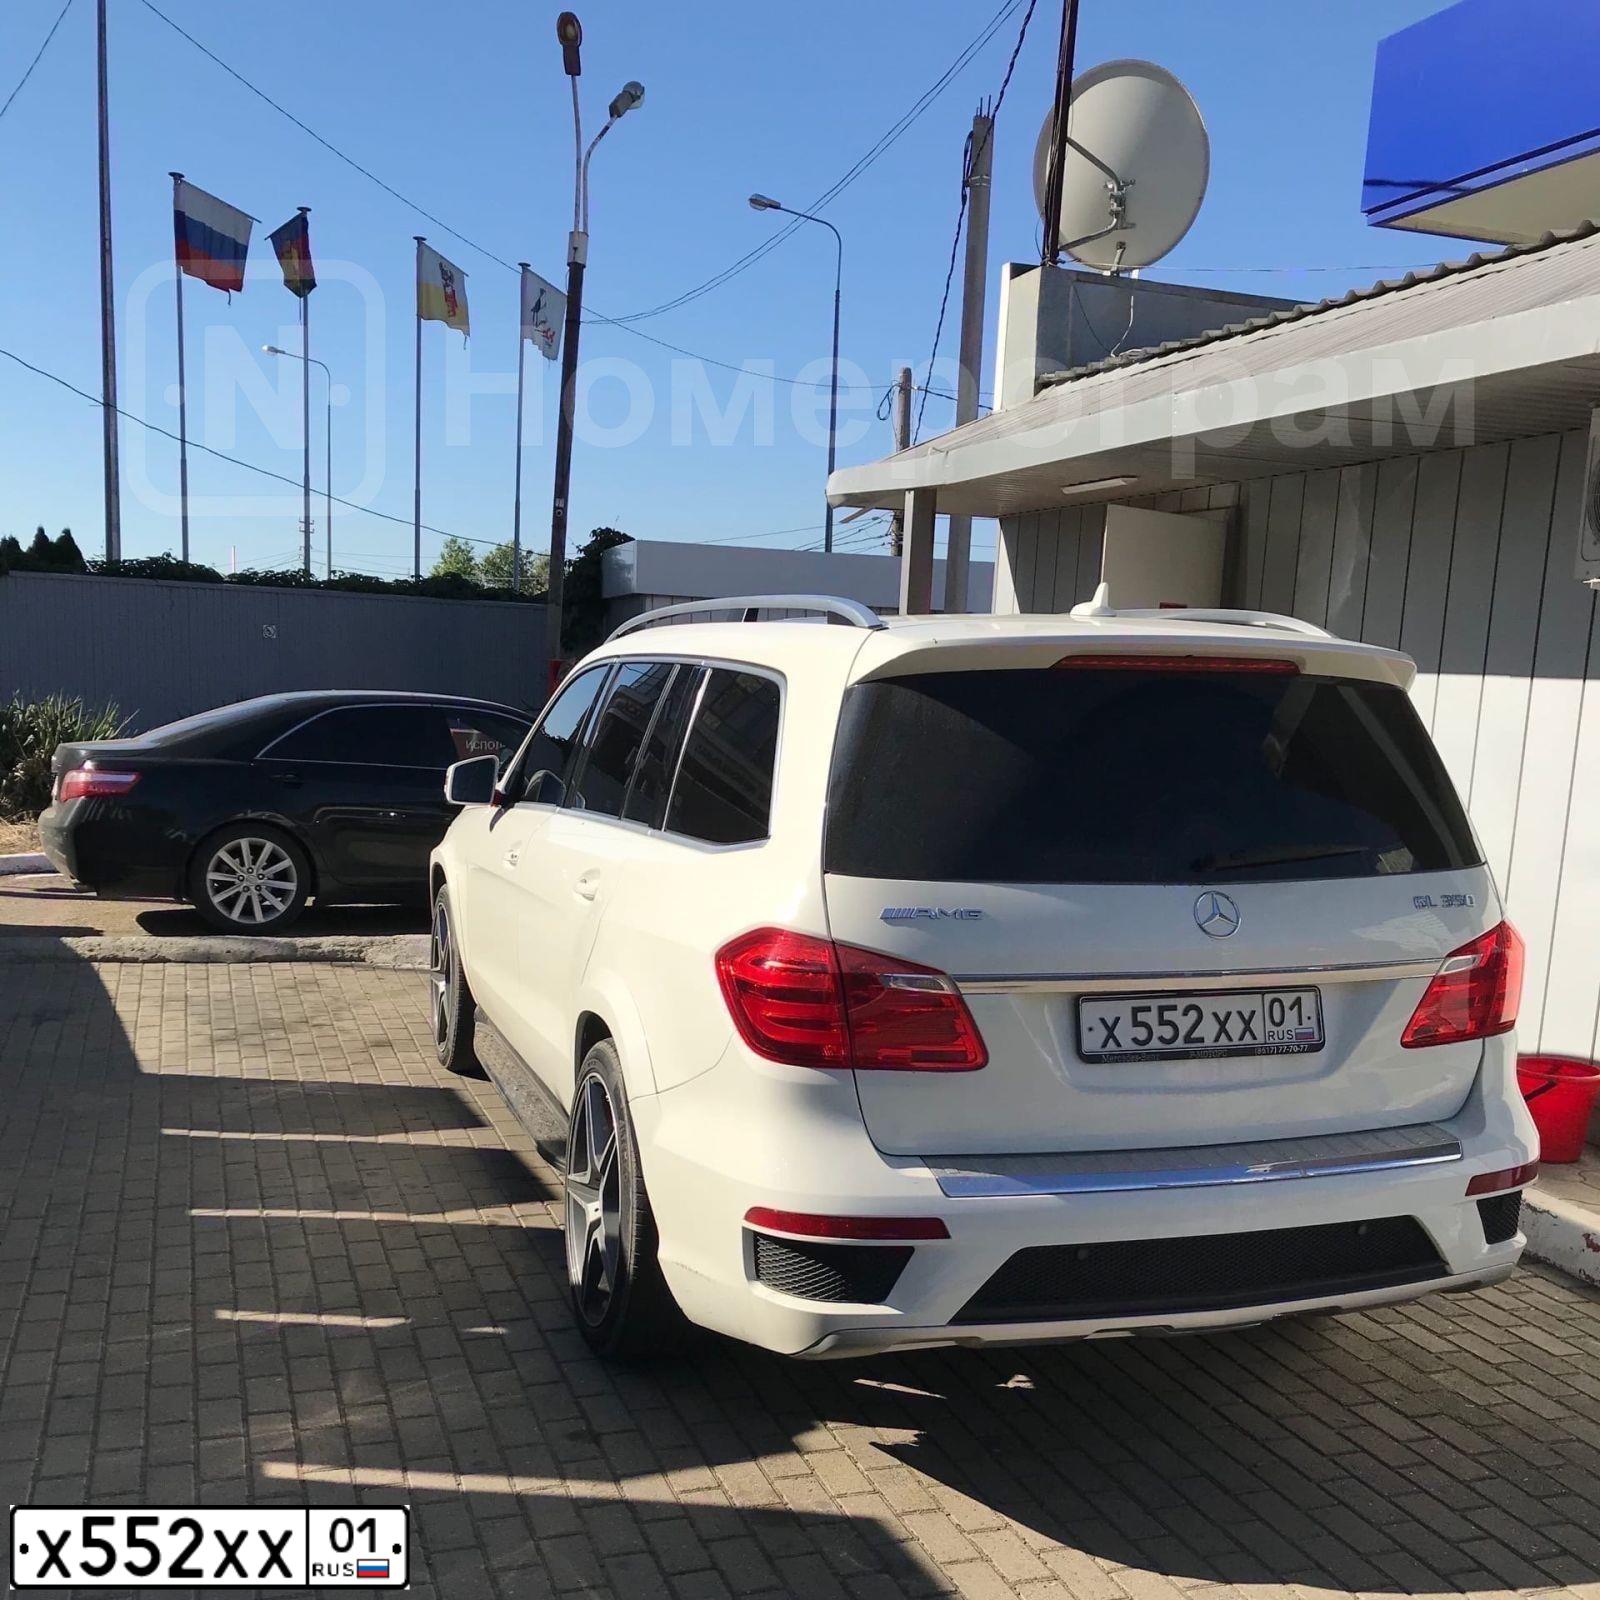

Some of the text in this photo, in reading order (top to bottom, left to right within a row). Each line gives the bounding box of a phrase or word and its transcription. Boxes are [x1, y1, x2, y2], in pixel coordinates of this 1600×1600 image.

[1413, 895, 1437, 908] GL
[911, 907, 983, 920] AMG
[1268, 996, 1304, 1027] 01
[1267, 1030, 1293, 1041] RUS
